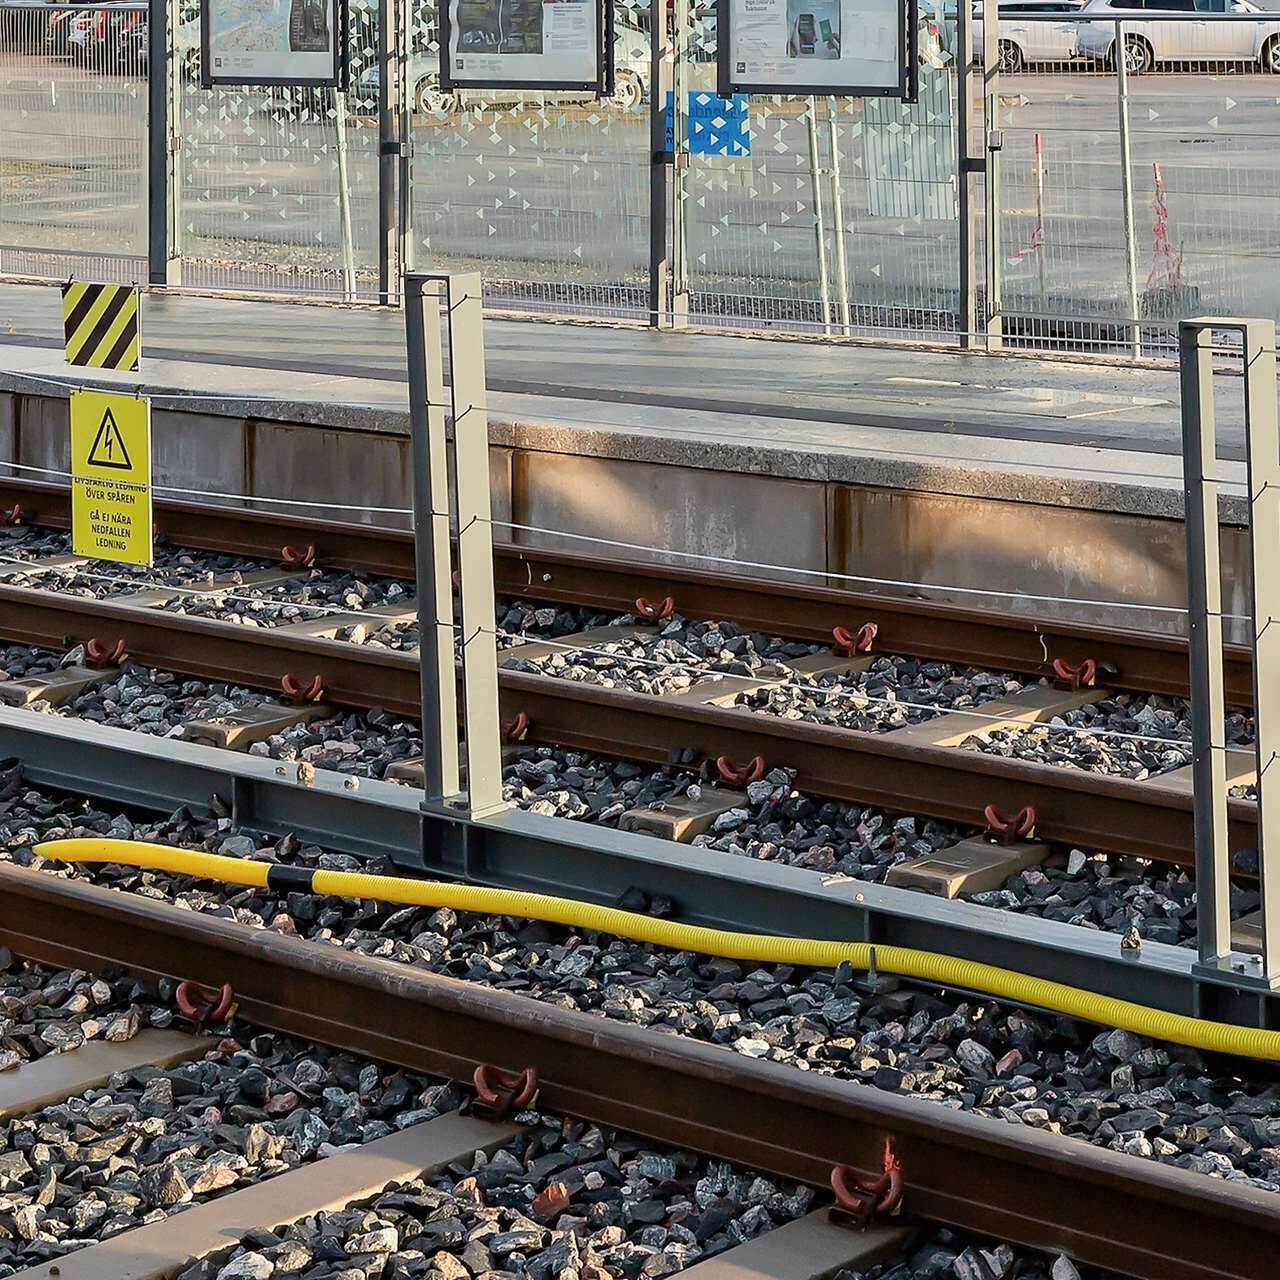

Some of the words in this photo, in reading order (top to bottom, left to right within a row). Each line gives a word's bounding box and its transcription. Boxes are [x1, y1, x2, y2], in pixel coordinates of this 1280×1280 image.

[86, 486, 105, 499] ÖVER
[107, 491, 136, 505] SPÅREN
[90, 509, 100, 520] GÅ
[102, 512, 110, 522] EJ
[111, 512, 132, 525] NÄRA
[91, 524, 131, 538] NEDFALLEN
[96, 538, 127, 550] LEDNING
